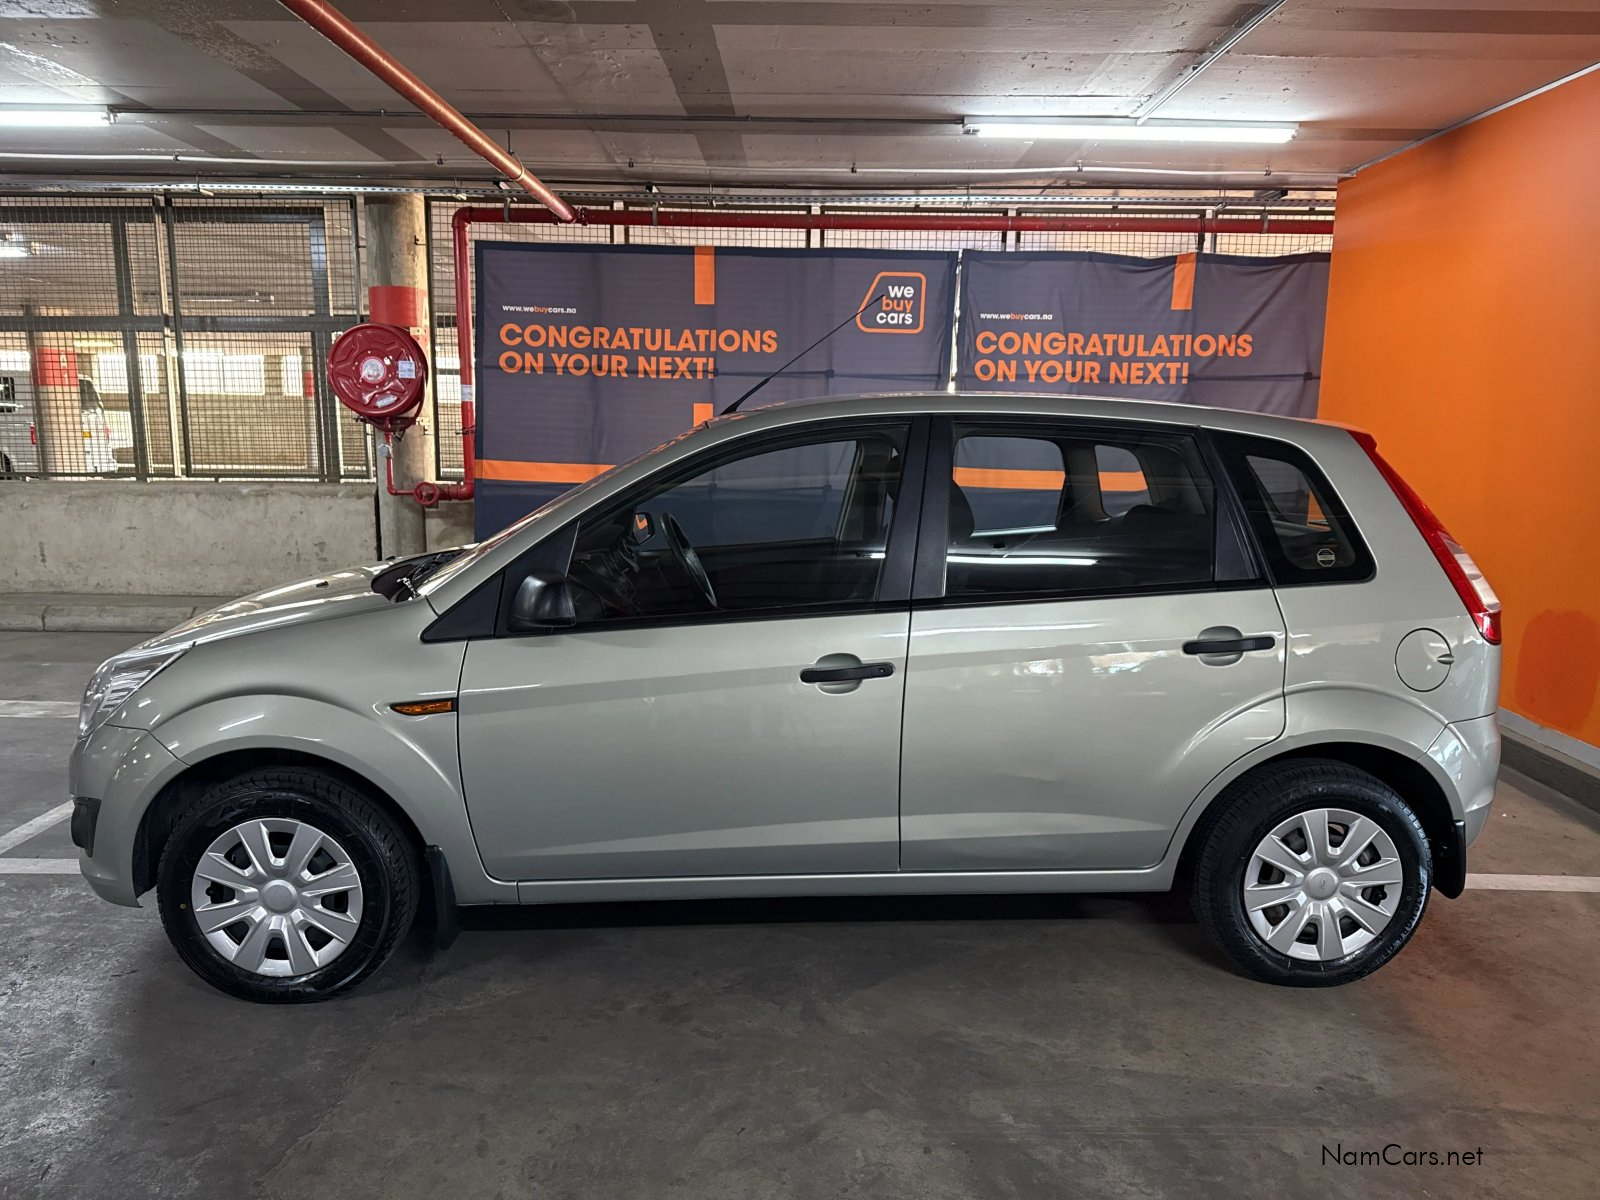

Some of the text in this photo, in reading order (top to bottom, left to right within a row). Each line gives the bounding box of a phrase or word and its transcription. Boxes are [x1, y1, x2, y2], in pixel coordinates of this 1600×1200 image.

[888, 286, 914, 298] we
[502, 305, 577, 314] www.webuycars.na
[882, 295, 913, 313] buy
[876, 312, 913, 325] cars
[980, 312, 1053, 321] www.webuycars.na
[499, 322, 778, 353] CONGRATULATIONS
[975, 331, 1253, 357] CONGRATULATIONS
[498, 350, 715, 379] ON YOUR NEXT!
[974, 358, 1189, 384] ON YOUR NEXT!
